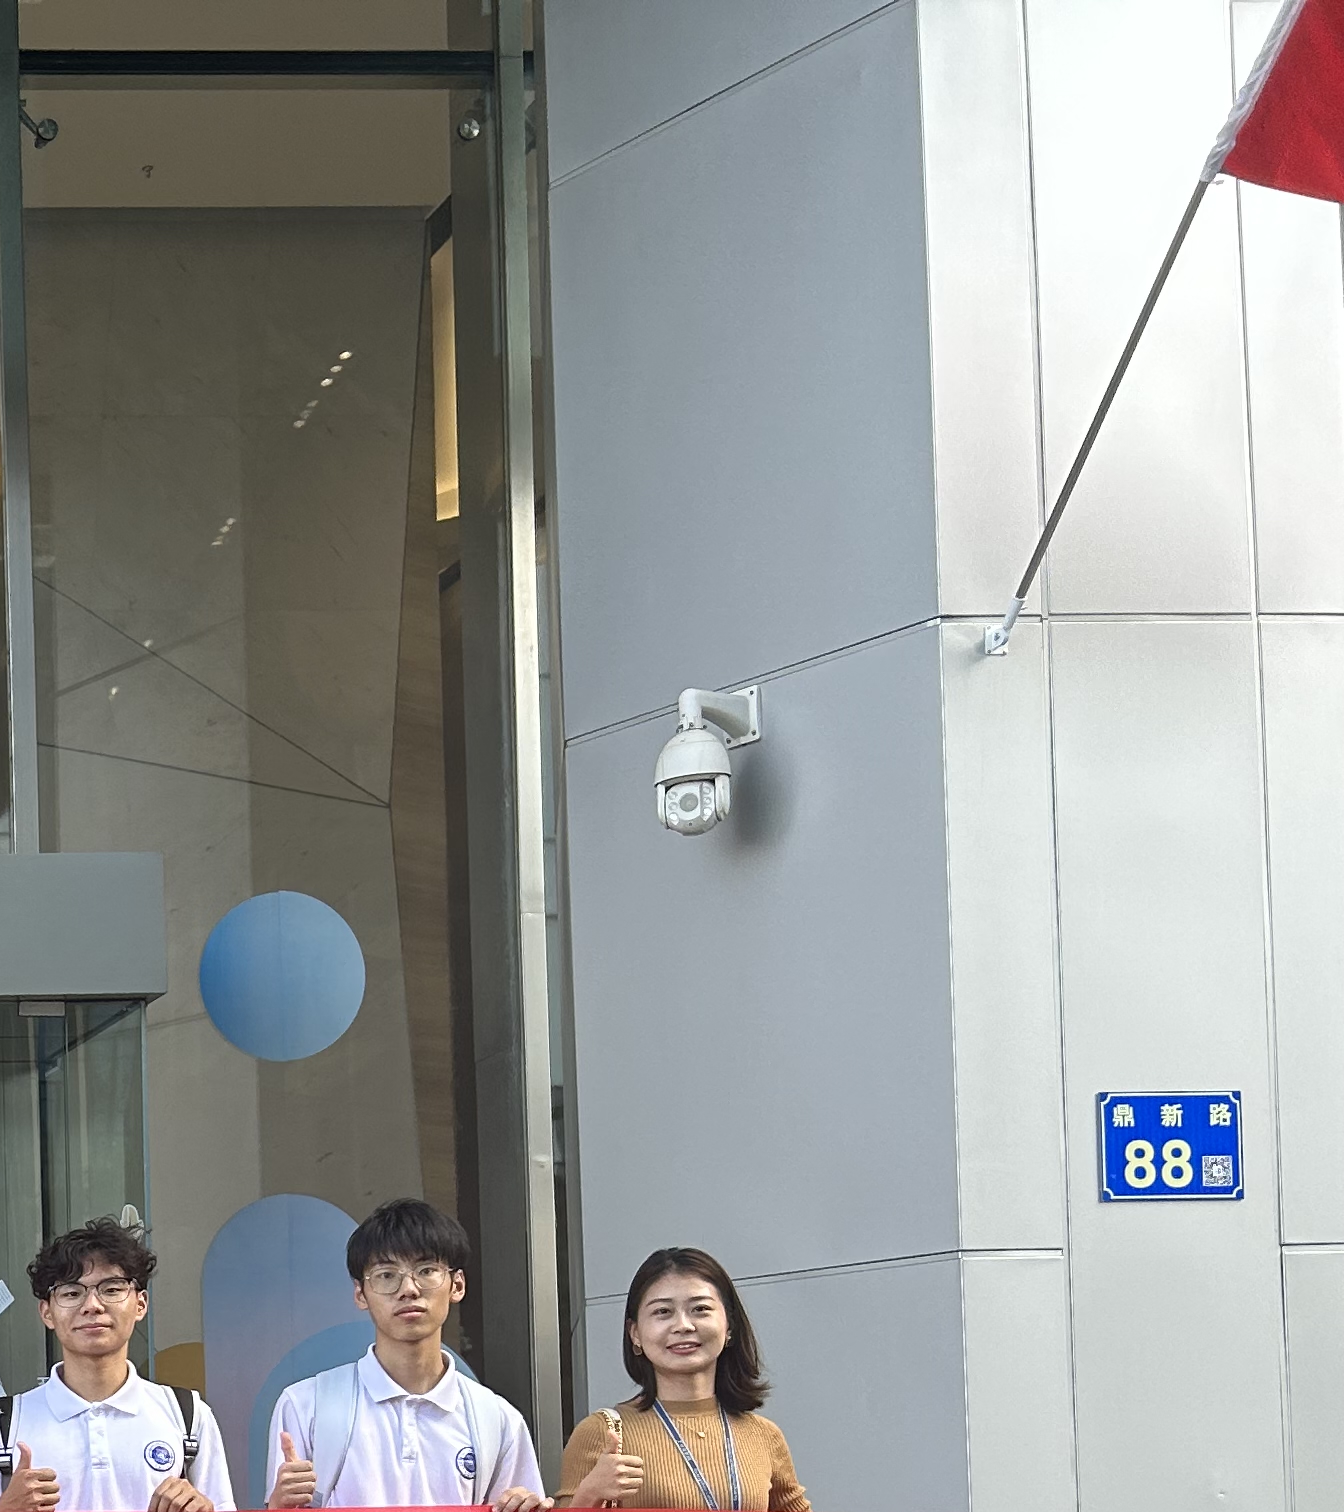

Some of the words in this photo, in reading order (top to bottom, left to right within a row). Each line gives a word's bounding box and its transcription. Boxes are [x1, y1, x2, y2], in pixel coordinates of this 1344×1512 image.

[1112, 1103, 1232, 1127] 鼎新路
[1124, 1139, 1194, 1188] 88
